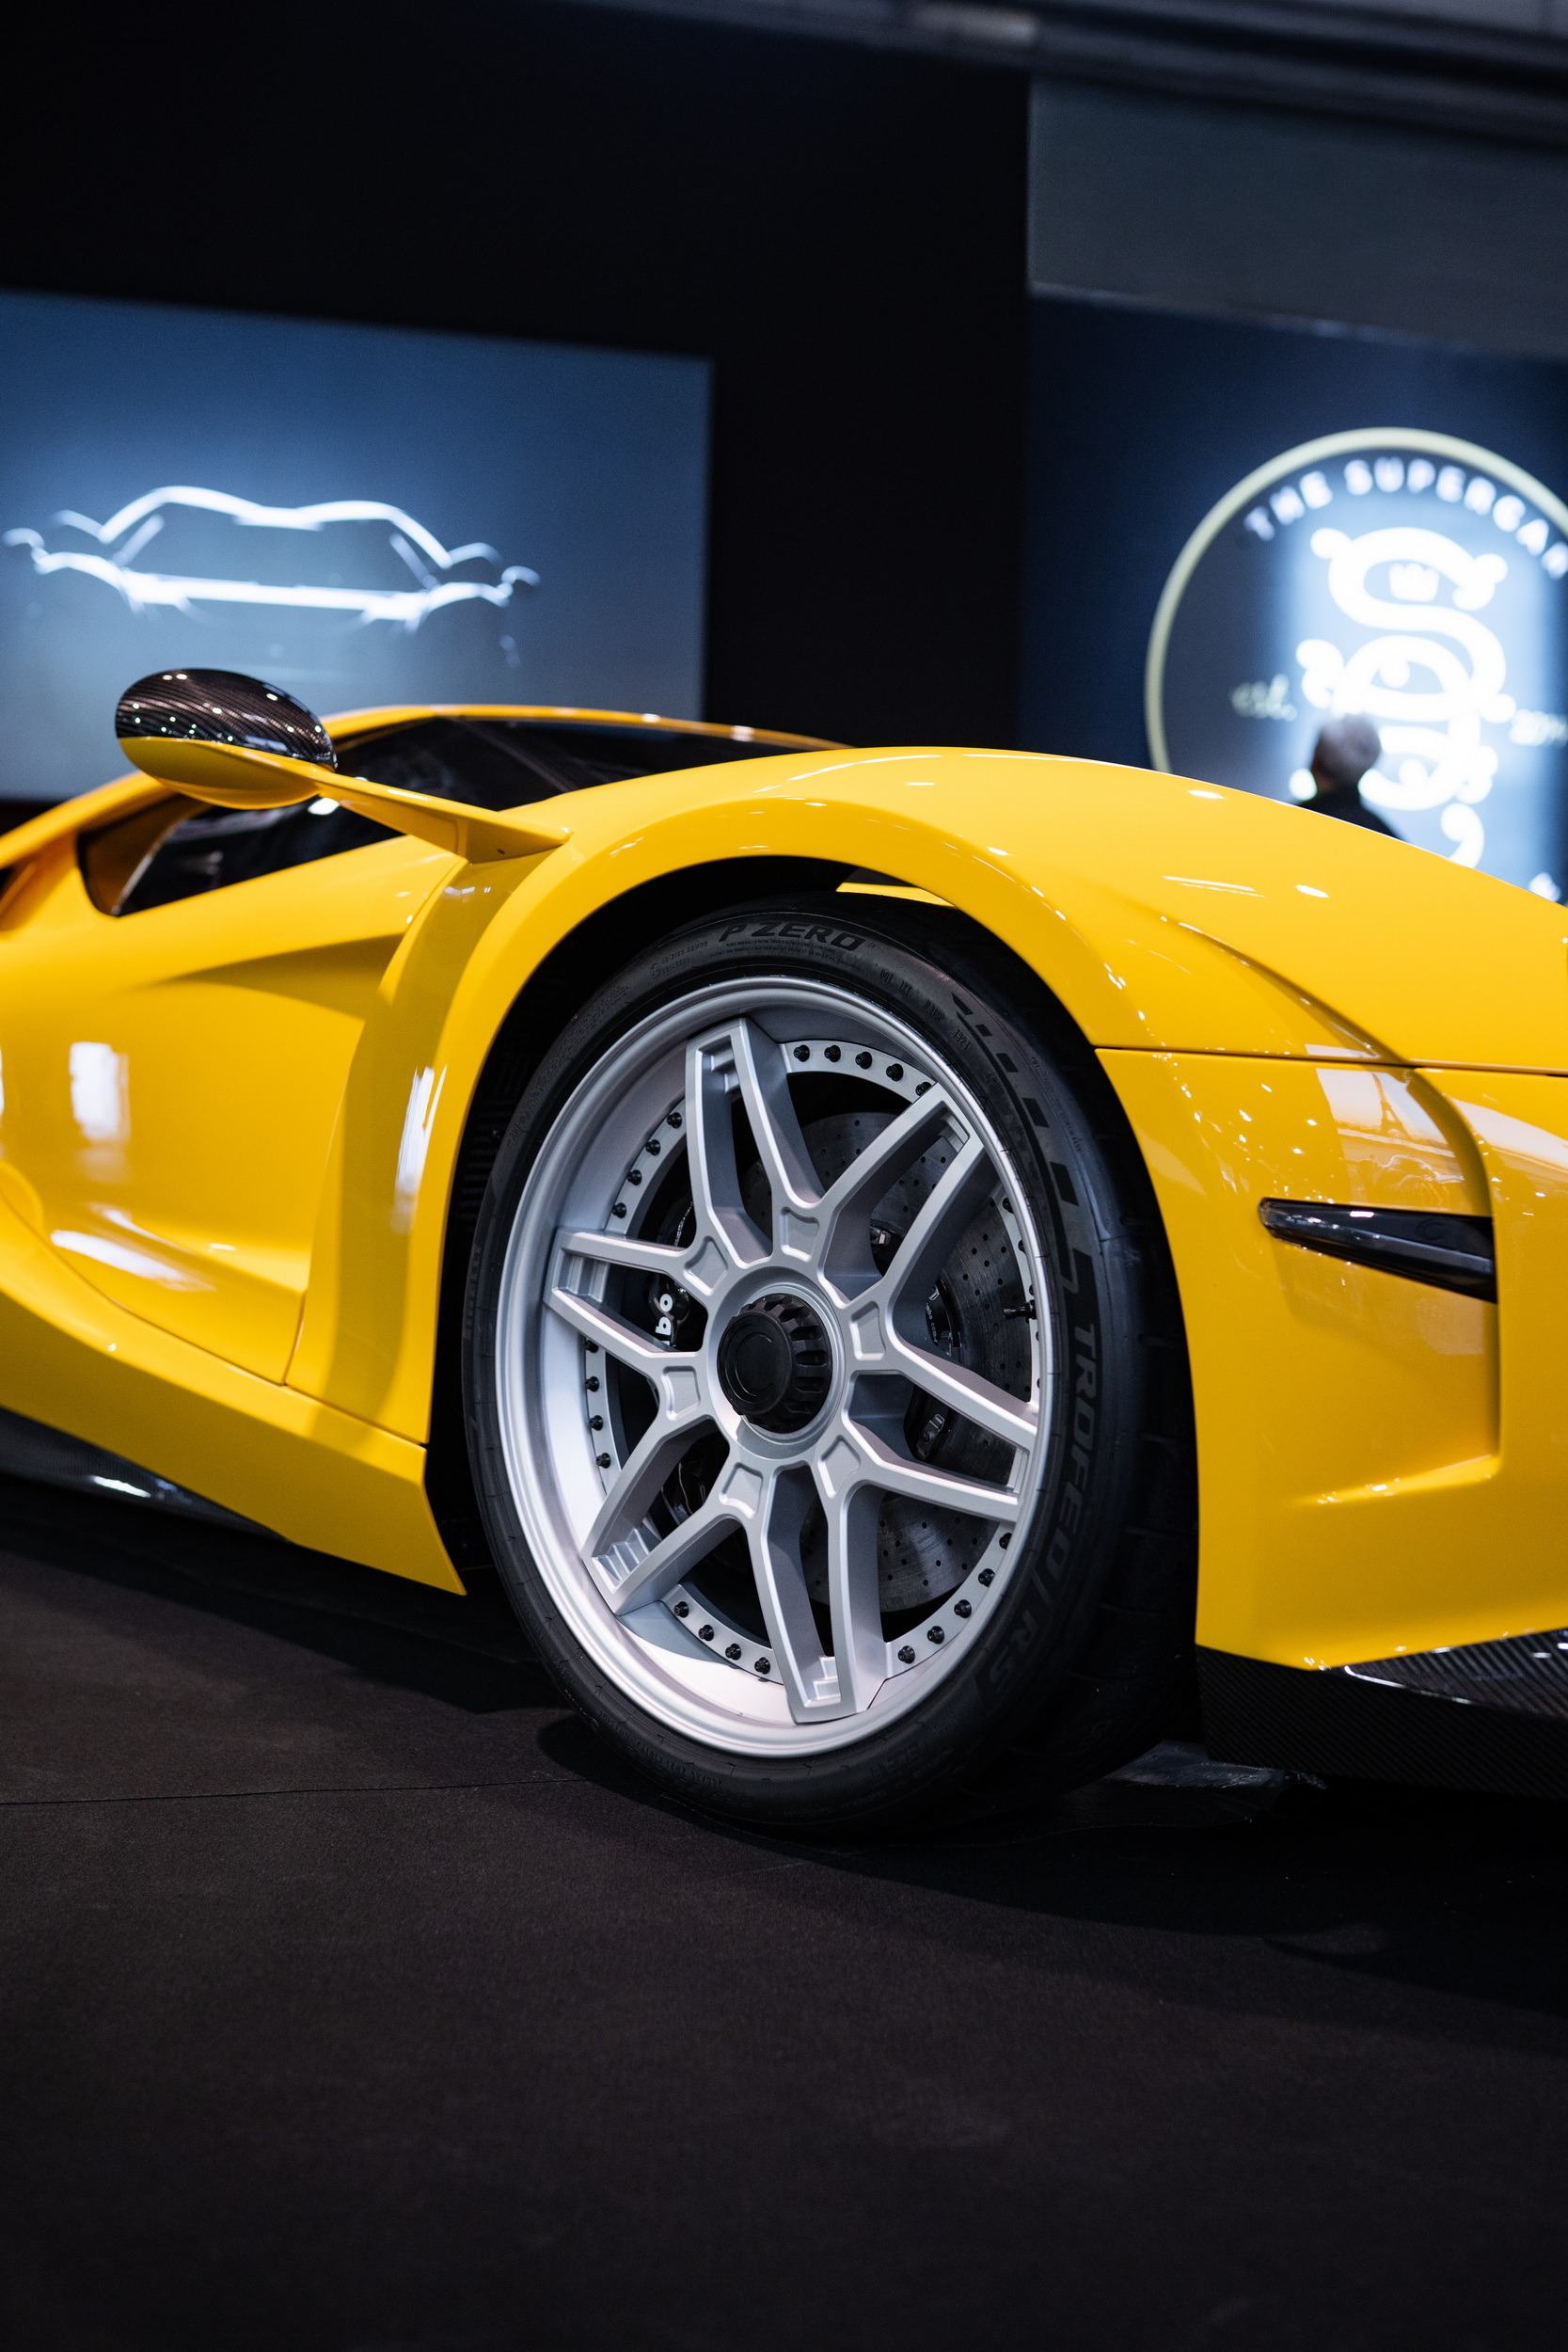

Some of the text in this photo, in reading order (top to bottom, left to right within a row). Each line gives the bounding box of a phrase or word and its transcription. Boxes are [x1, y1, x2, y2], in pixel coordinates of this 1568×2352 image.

[719, 923, 748, 942] P
[751, 921, 866, 952] ZERO
[990, 1323, 1097, 1689] TROFEO RS
